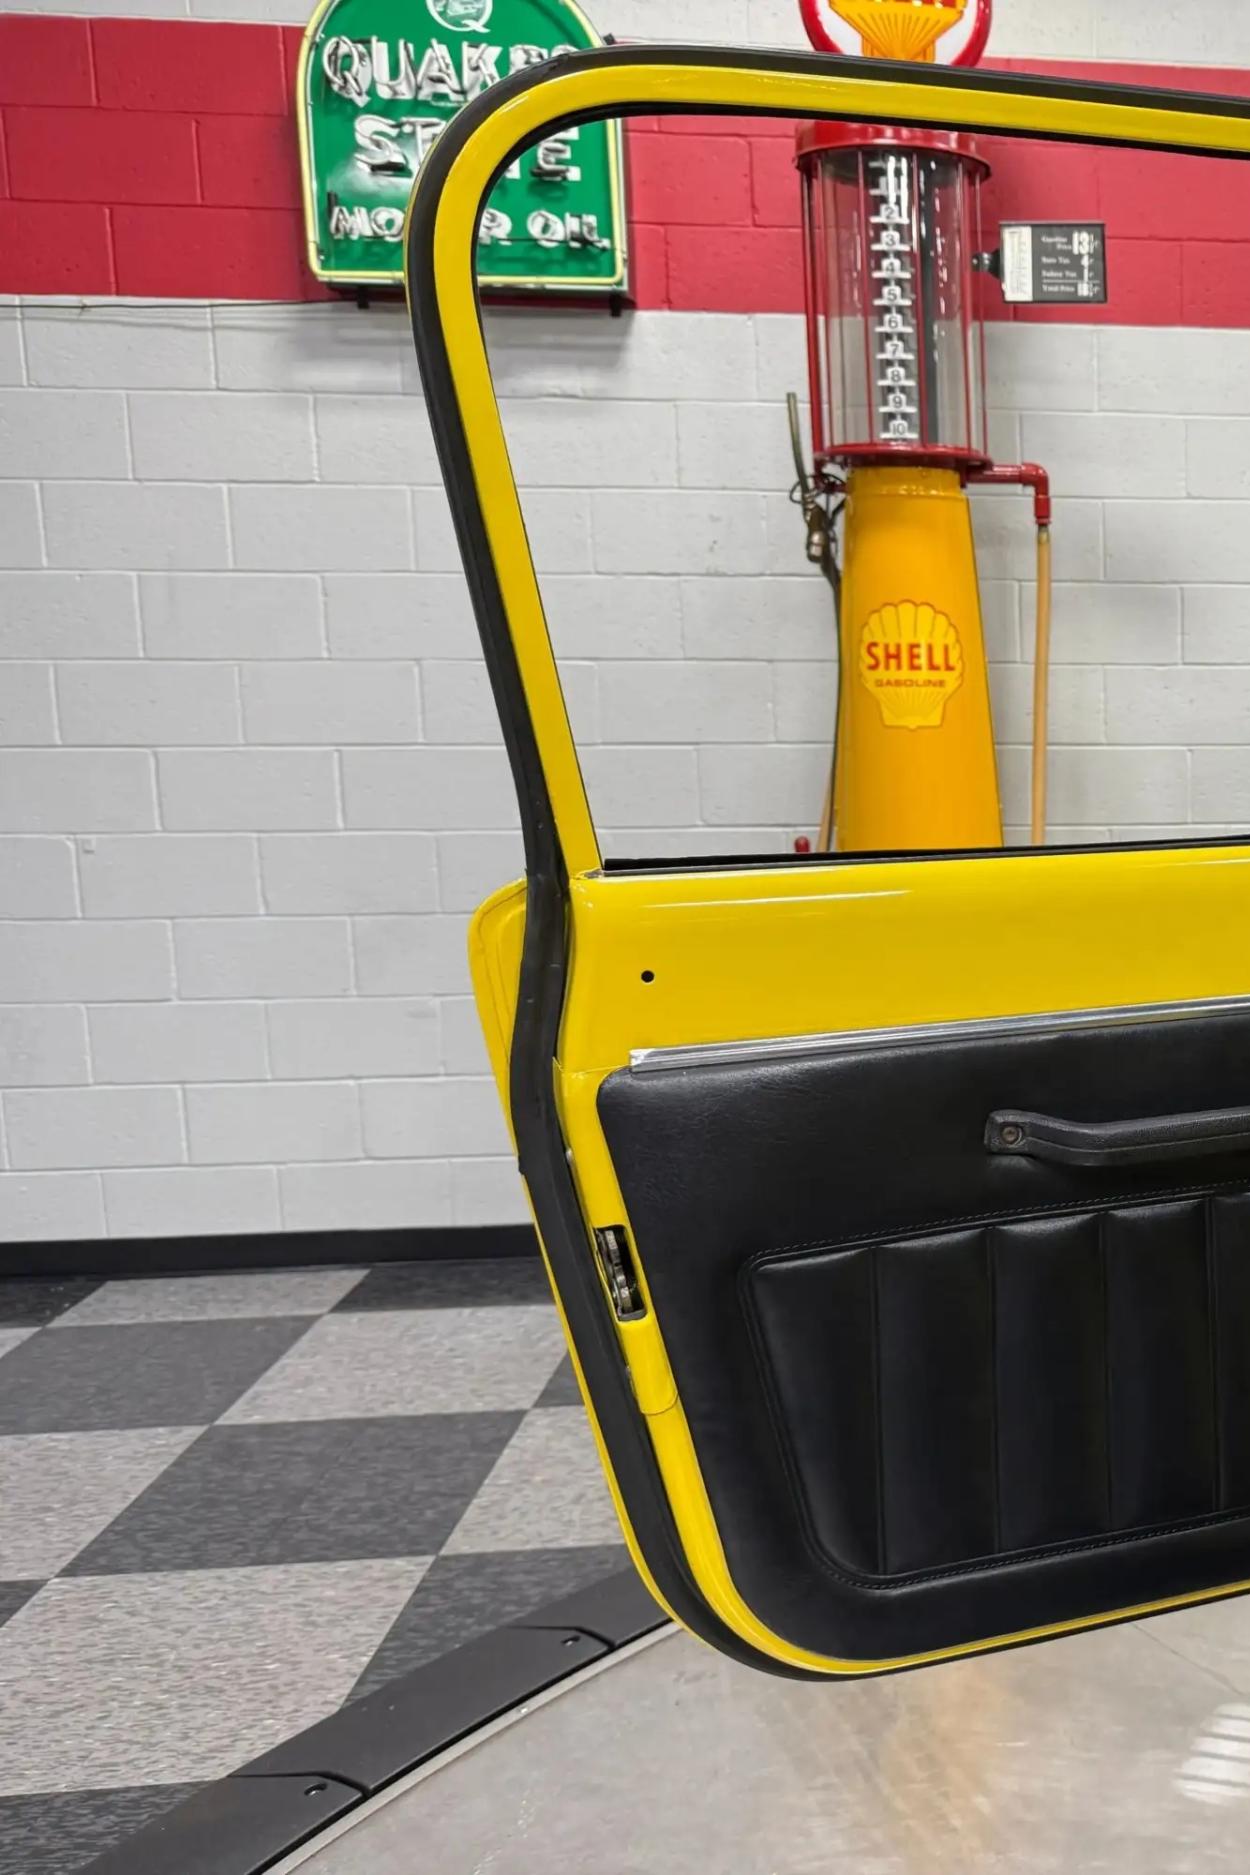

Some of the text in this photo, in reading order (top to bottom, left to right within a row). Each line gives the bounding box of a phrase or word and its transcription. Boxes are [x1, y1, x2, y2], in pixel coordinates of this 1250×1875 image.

[354, 114, 581, 181] STE
[885, 206, 894, 219] 2
[331, 206, 610, 250] MOR OIL
[885, 233, 895, 246] 3
[885, 262, 895, 273] 4
[887, 288, 897, 301] 5
[888, 316, 898, 329] 6
[890, 343, 899, 355] 7
[891, 370, 901, 382] 8
[892, 395, 902, 409] 9
[892, 423, 905, 435] 10
[866, 641, 955, 671] SHELL
[875, 678, 945, 688] GASOLINE
